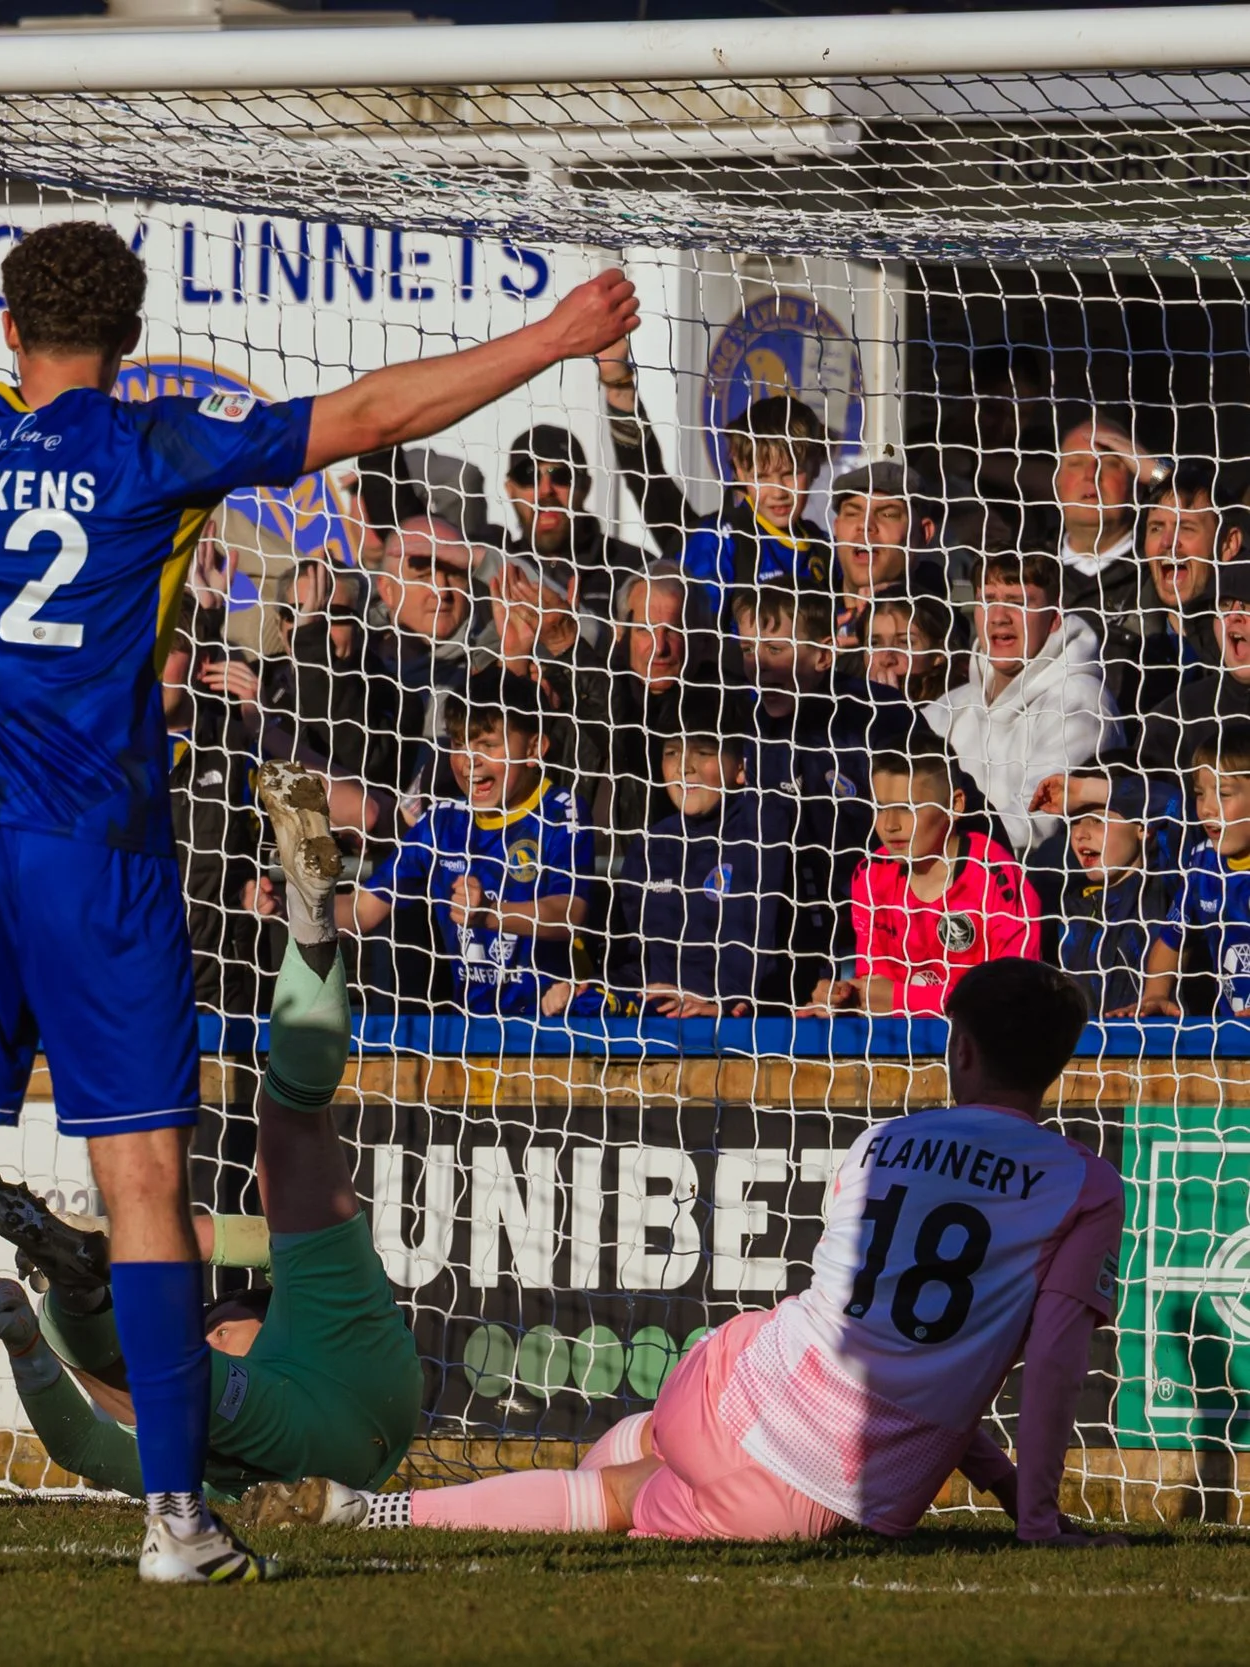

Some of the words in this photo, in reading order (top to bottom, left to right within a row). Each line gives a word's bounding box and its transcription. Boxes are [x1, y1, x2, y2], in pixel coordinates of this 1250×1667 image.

[182, 217, 549, 303] LINNETS
[859, 1135, 1046, 1200] FLANNERY
[842, 1183, 992, 1344] 18
